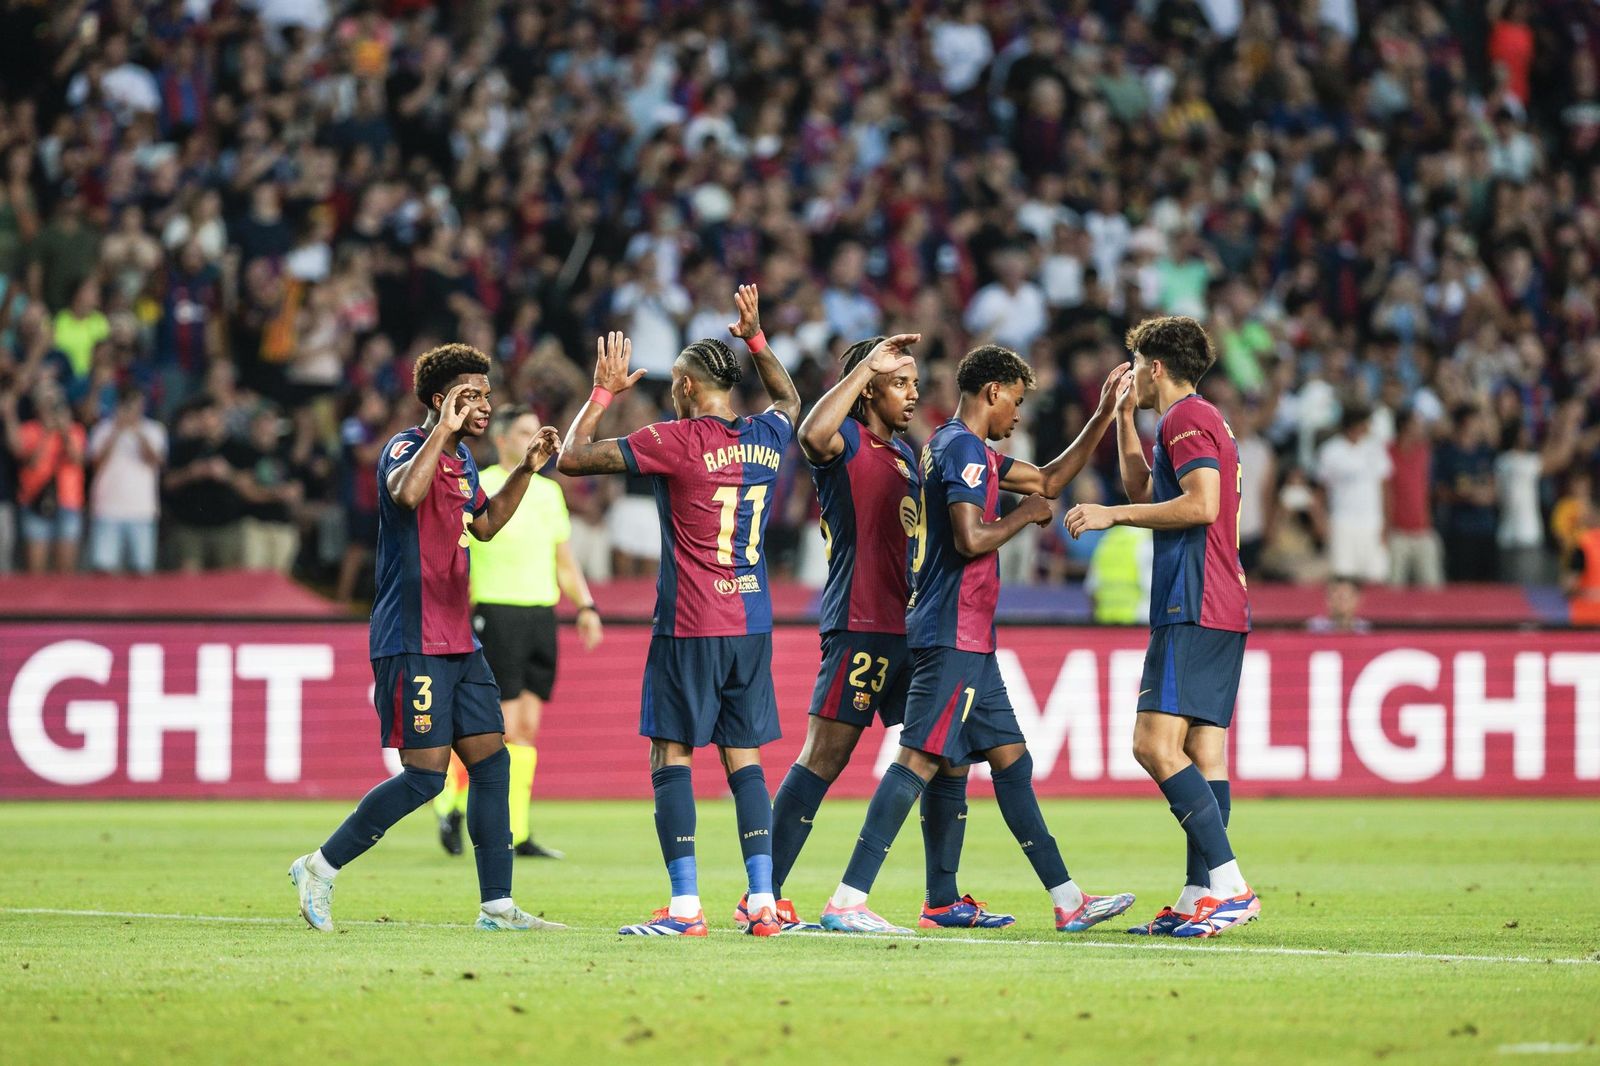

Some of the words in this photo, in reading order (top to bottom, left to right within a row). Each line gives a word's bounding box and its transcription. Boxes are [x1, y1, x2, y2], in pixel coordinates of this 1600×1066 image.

[703, 444, 781, 472] RAPHINHA
[711, 485, 768, 566] 11
[849, 652, 889, 692] 23
[8, 639, 334, 785] GHT
[413, 675, 433, 711] 3
[963, 687, 976, 723] 1
